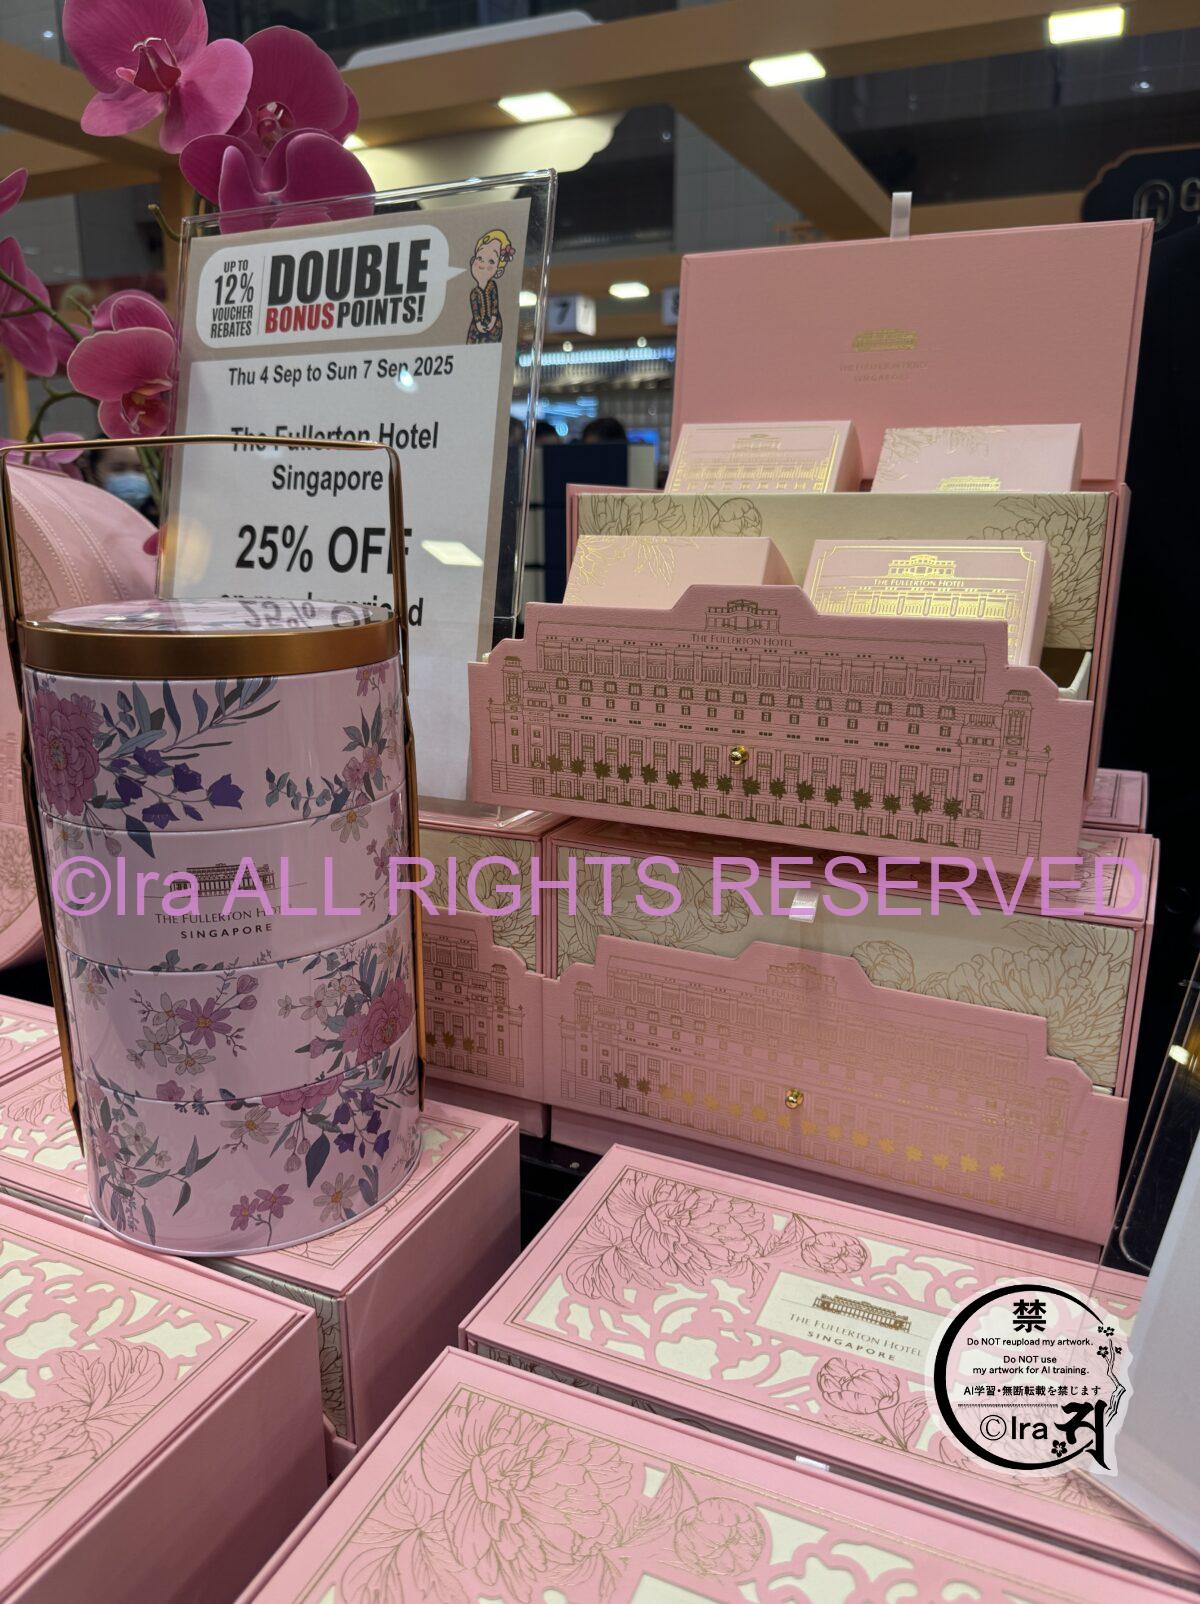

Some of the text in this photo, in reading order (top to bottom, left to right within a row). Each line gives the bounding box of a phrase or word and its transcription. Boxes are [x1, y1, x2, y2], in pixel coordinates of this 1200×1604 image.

[223, 260, 249, 273] UP TO
[268, 239, 431, 306] DOUBLE
[214, 272, 254, 306] 12%
[212, 304, 254, 322] VOUCHER
[265, 295, 426, 334] BONUS POINTS!
[210, 320, 252, 338] REBATES
[228, 355, 454, 387] Thu 4 Sep to Sun 7 Sep 2025
[379, 421, 439, 450] Hotel
[272, 464, 384, 497] Singapore
[235, 524, 314, 573] 25%
[692, 633, 792, 648] THE FULLERTON HOTEL
[155, 912, 179, 924] THE
[180, 923, 273, 939] SINGAPORE
[790, 1313, 810, 1325] THE
[814, 1319, 881, 1345] FULLERTON
[807, 1331, 896, 1361] SINGAPORE
